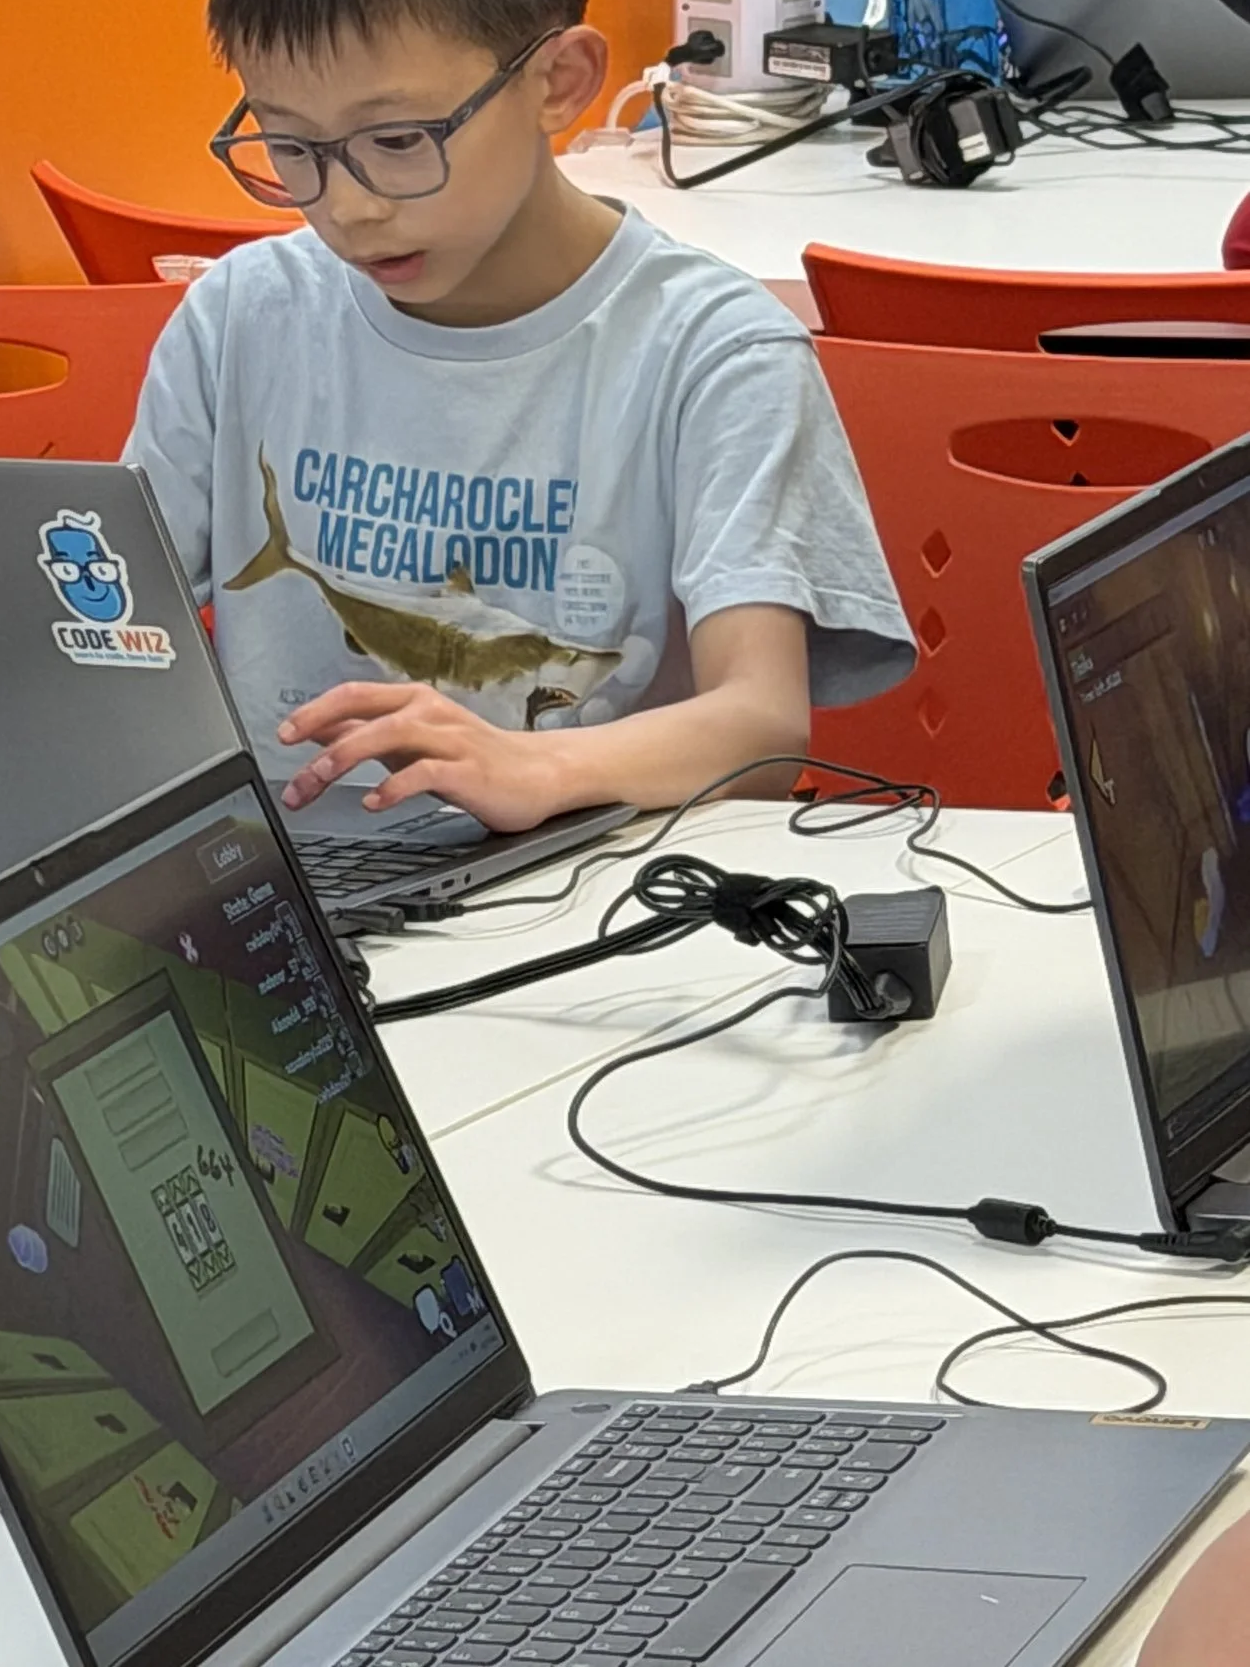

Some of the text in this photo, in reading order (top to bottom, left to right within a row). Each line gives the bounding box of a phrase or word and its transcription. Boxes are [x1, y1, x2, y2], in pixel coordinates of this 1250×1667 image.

[317, 510, 558, 592] MEGALODON
[57, 626, 170, 654] CODE WIZ
[212, 842, 245, 871] Lobby
